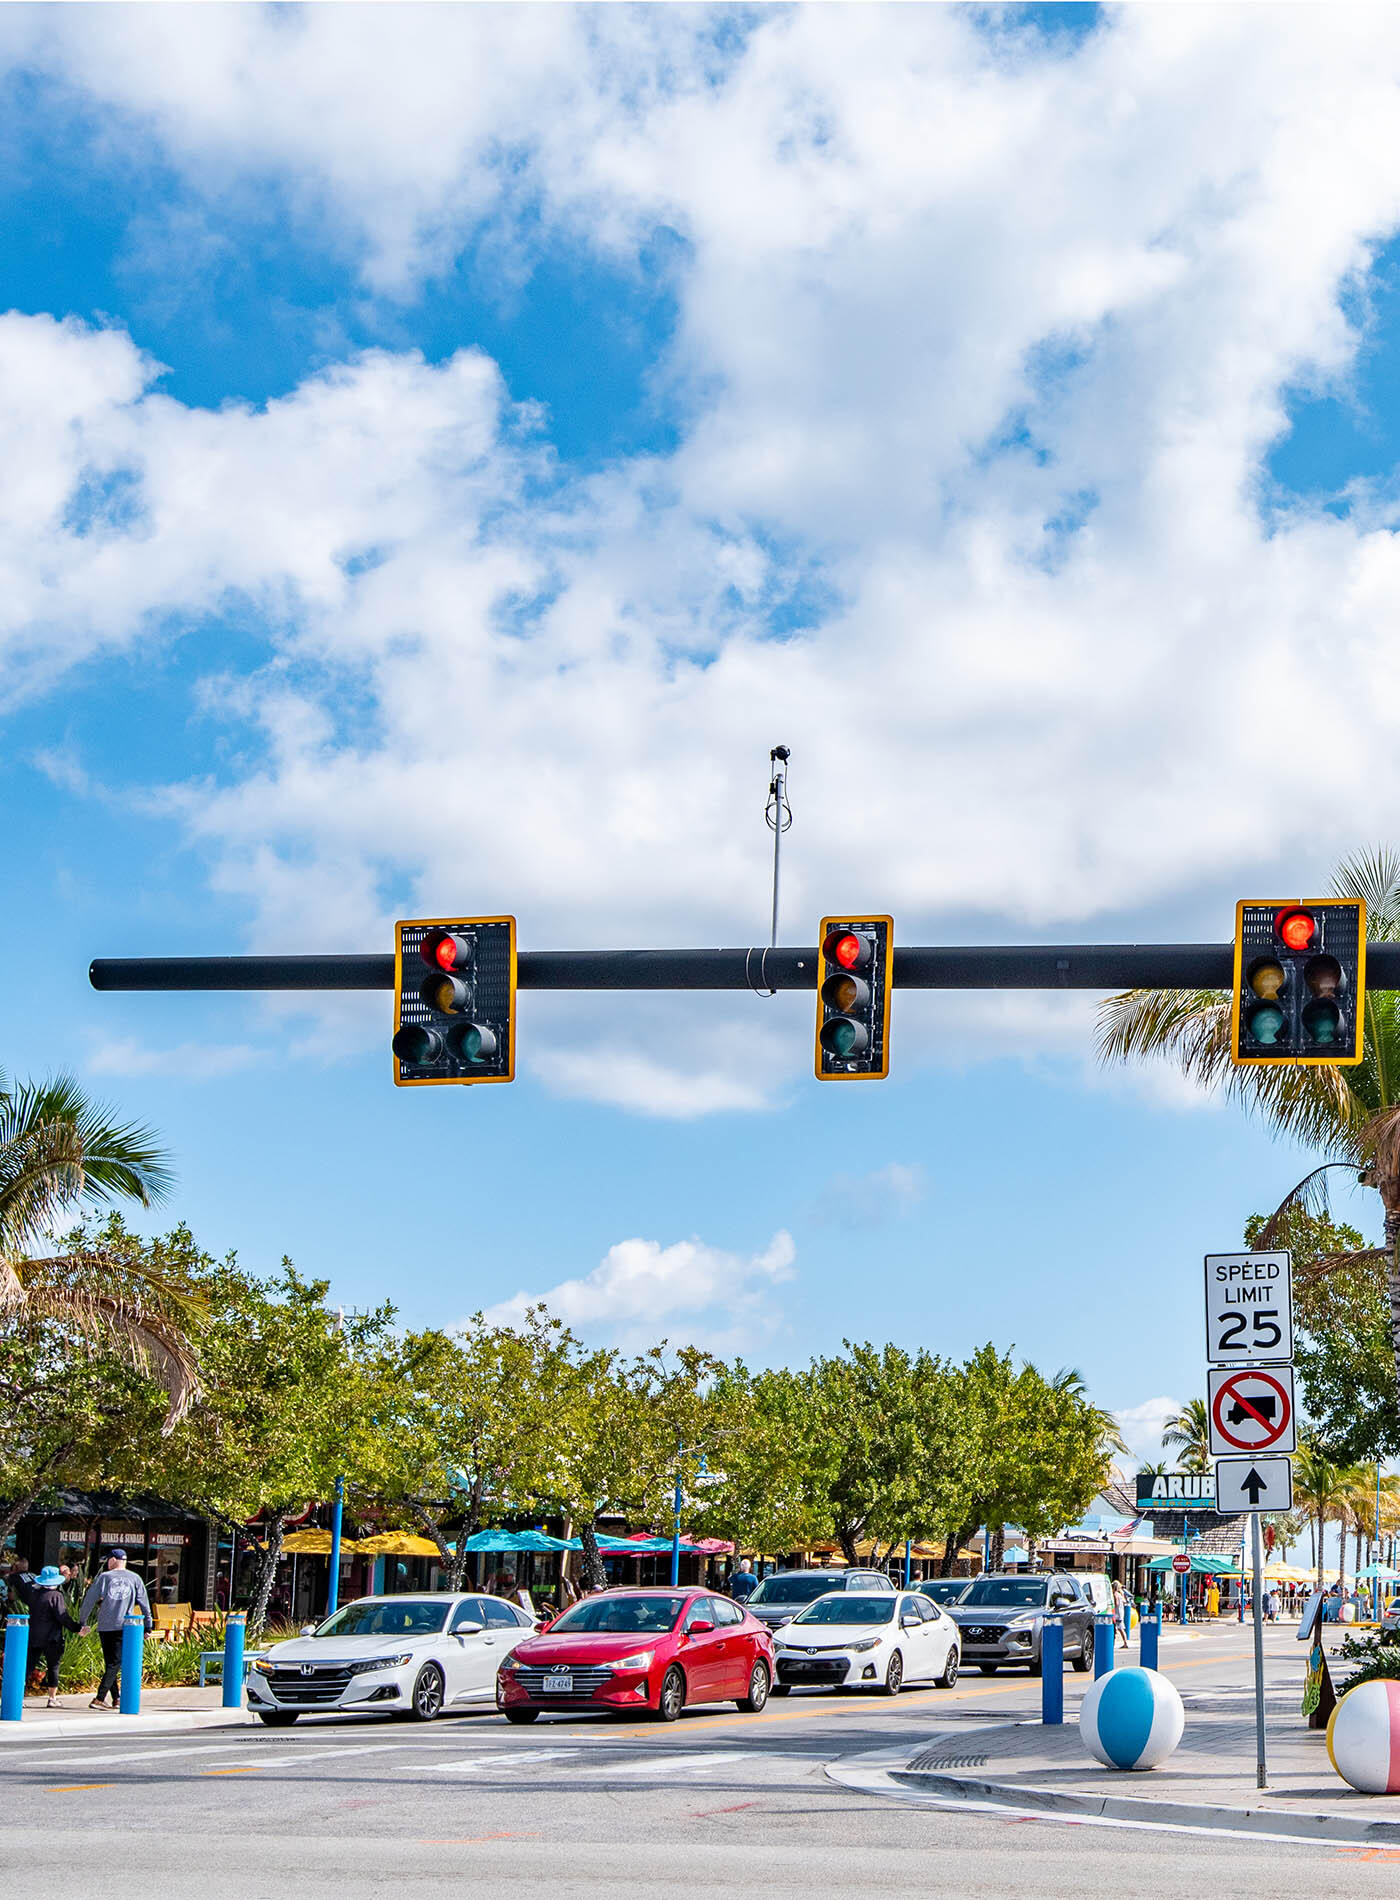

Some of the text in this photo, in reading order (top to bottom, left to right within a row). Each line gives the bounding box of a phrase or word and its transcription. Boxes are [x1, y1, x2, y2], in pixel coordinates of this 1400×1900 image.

[1216, 1263, 1280, 1281] SPEED
[1225, 1286, 1273, 1304] LIMIT
[1217, 1310, 1282, 1350] 25
[1151, 1475, 1215, 1498] ARUB
[69, 1531, 86, 1542] CREAM
